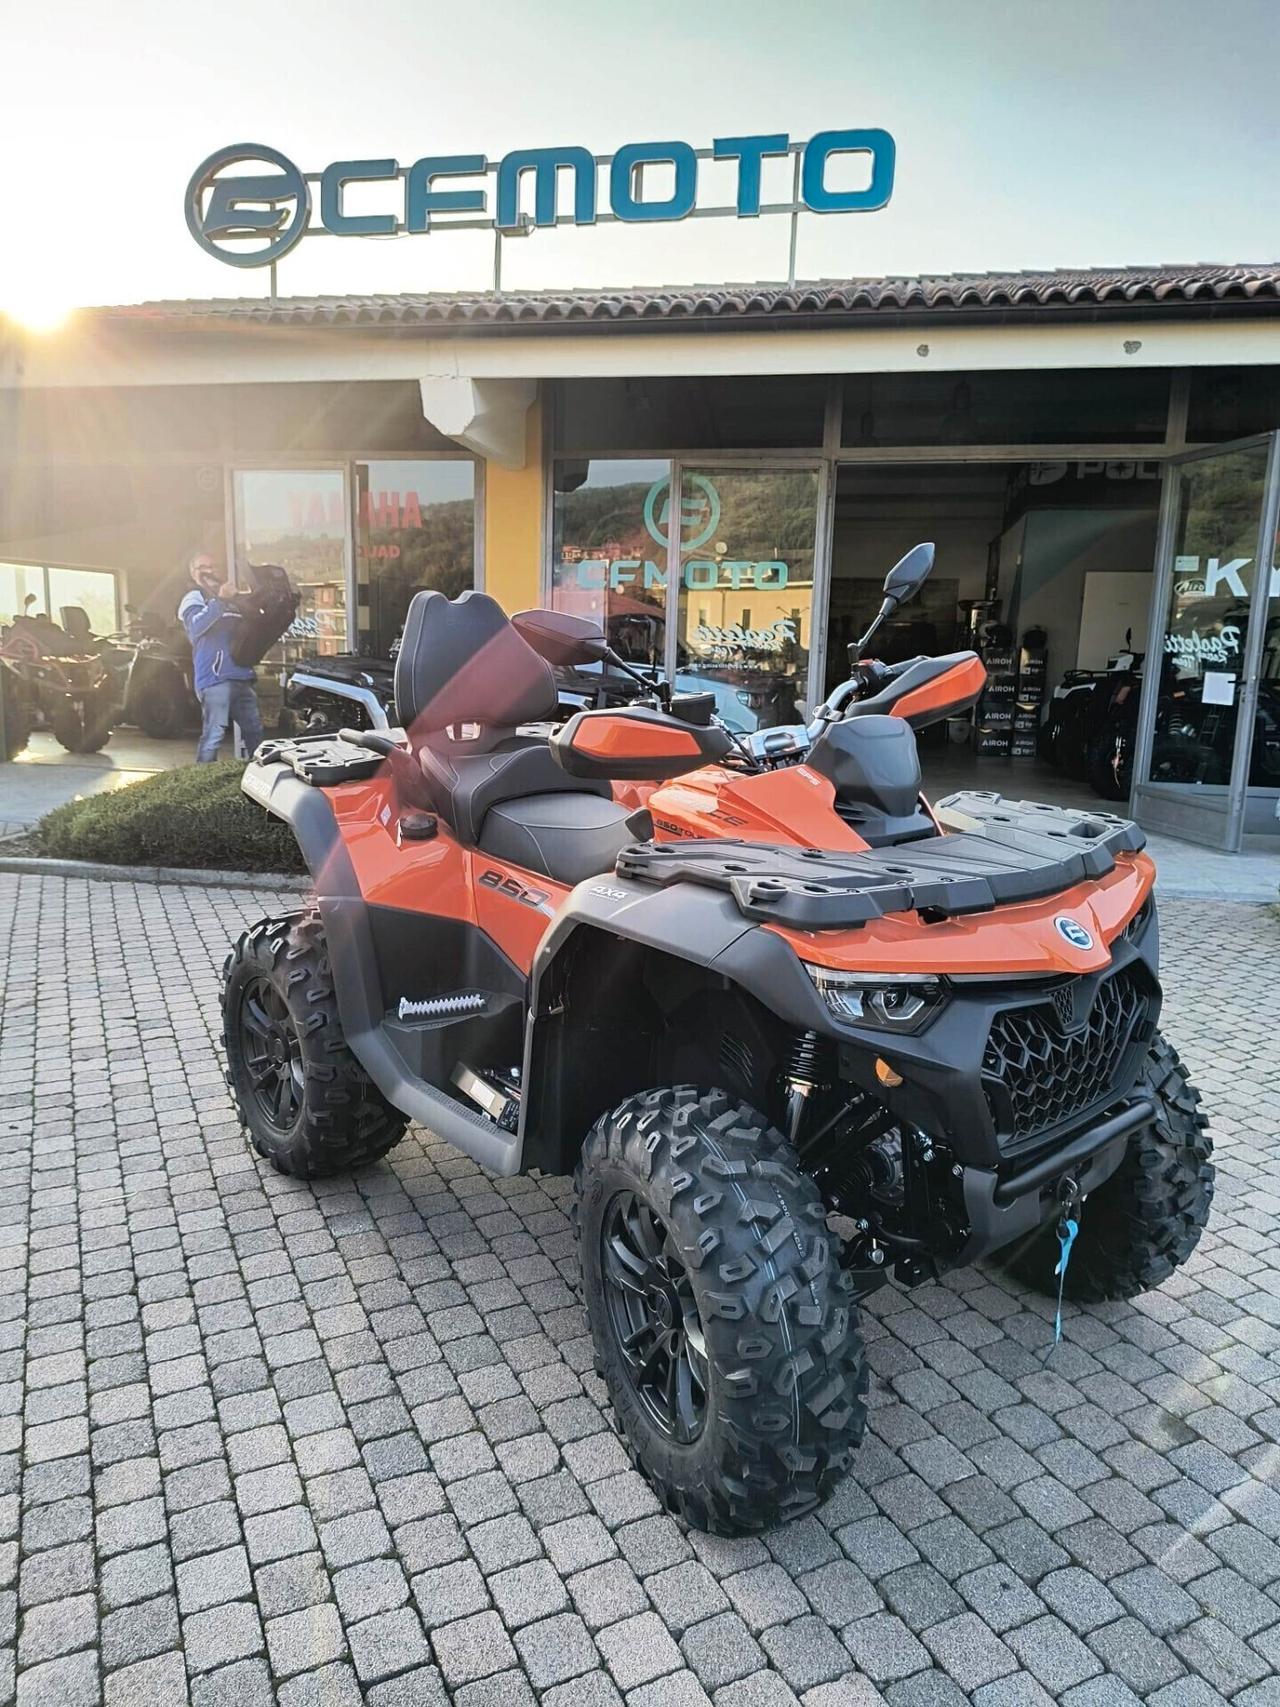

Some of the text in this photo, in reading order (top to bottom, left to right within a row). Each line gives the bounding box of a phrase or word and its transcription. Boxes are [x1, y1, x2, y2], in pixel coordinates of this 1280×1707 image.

[320, 127, 897, 235] CFMOTO
[1076, 461, 1163, 480] POL
[576, 560, 789, 590] CFMOTO
[986, 657, 1012, 665] AIROH
[981, 739, 1008, 747] AIROH
[479, 869, 551, 908] 850
